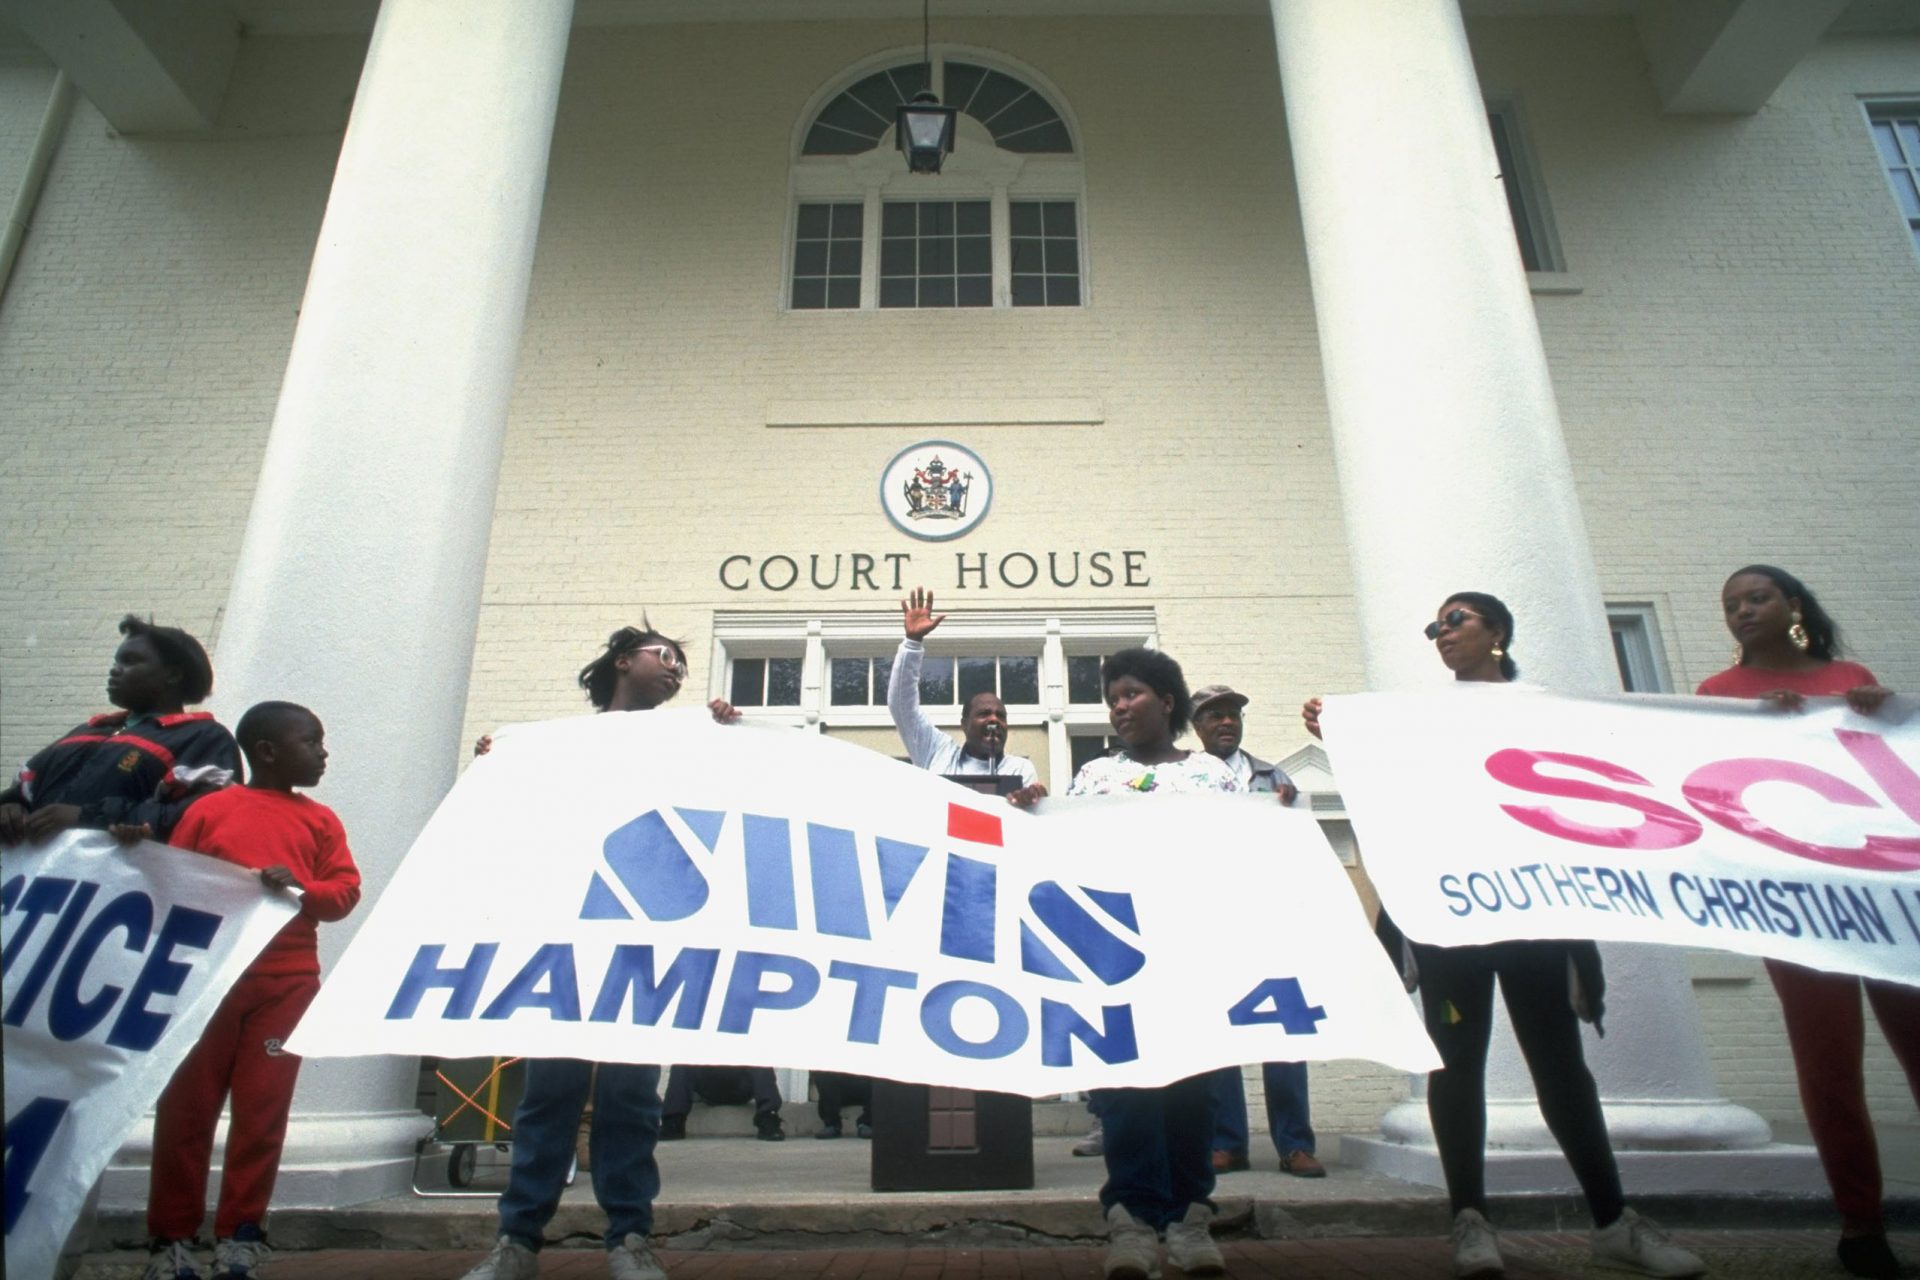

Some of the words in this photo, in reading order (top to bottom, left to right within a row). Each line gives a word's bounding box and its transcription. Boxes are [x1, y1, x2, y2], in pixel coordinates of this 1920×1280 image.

[719, 553, 911, 591] COURT
[955, 551, 1150, 588] HOUSE
[1439, 863, 1663, 919] SOUTHERN
[1669, 872, 1897, 946] CHRISTIAN
[385, 943, 1138, 1068] HAMPTON
[1228, 978, 1327, 1036] 4
